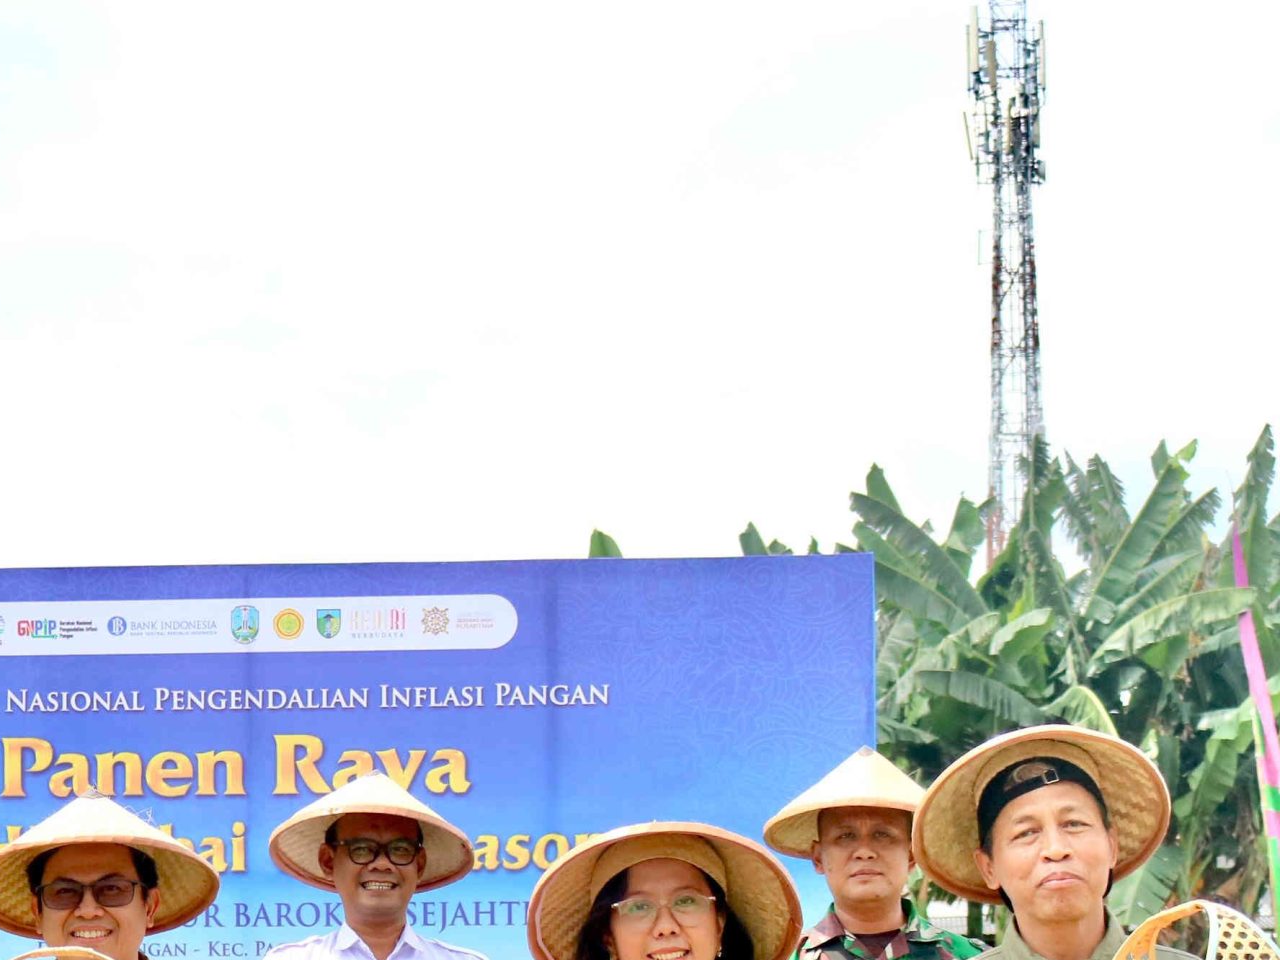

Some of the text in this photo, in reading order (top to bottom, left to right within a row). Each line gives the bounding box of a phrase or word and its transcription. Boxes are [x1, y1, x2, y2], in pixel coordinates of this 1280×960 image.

[130, 619, 217, 631] BANK INDONESIA
[4, 688, 145, 713] NASIONAL
[154, 686, 369, 711] PENGENDALIAN
[379, 684, 485, 708] INFLASI
[495, 682, 610, 706] PANGAN
[0, 733, 472, 798] Panen Raya
[234, 902, 343, 928] BAROK
